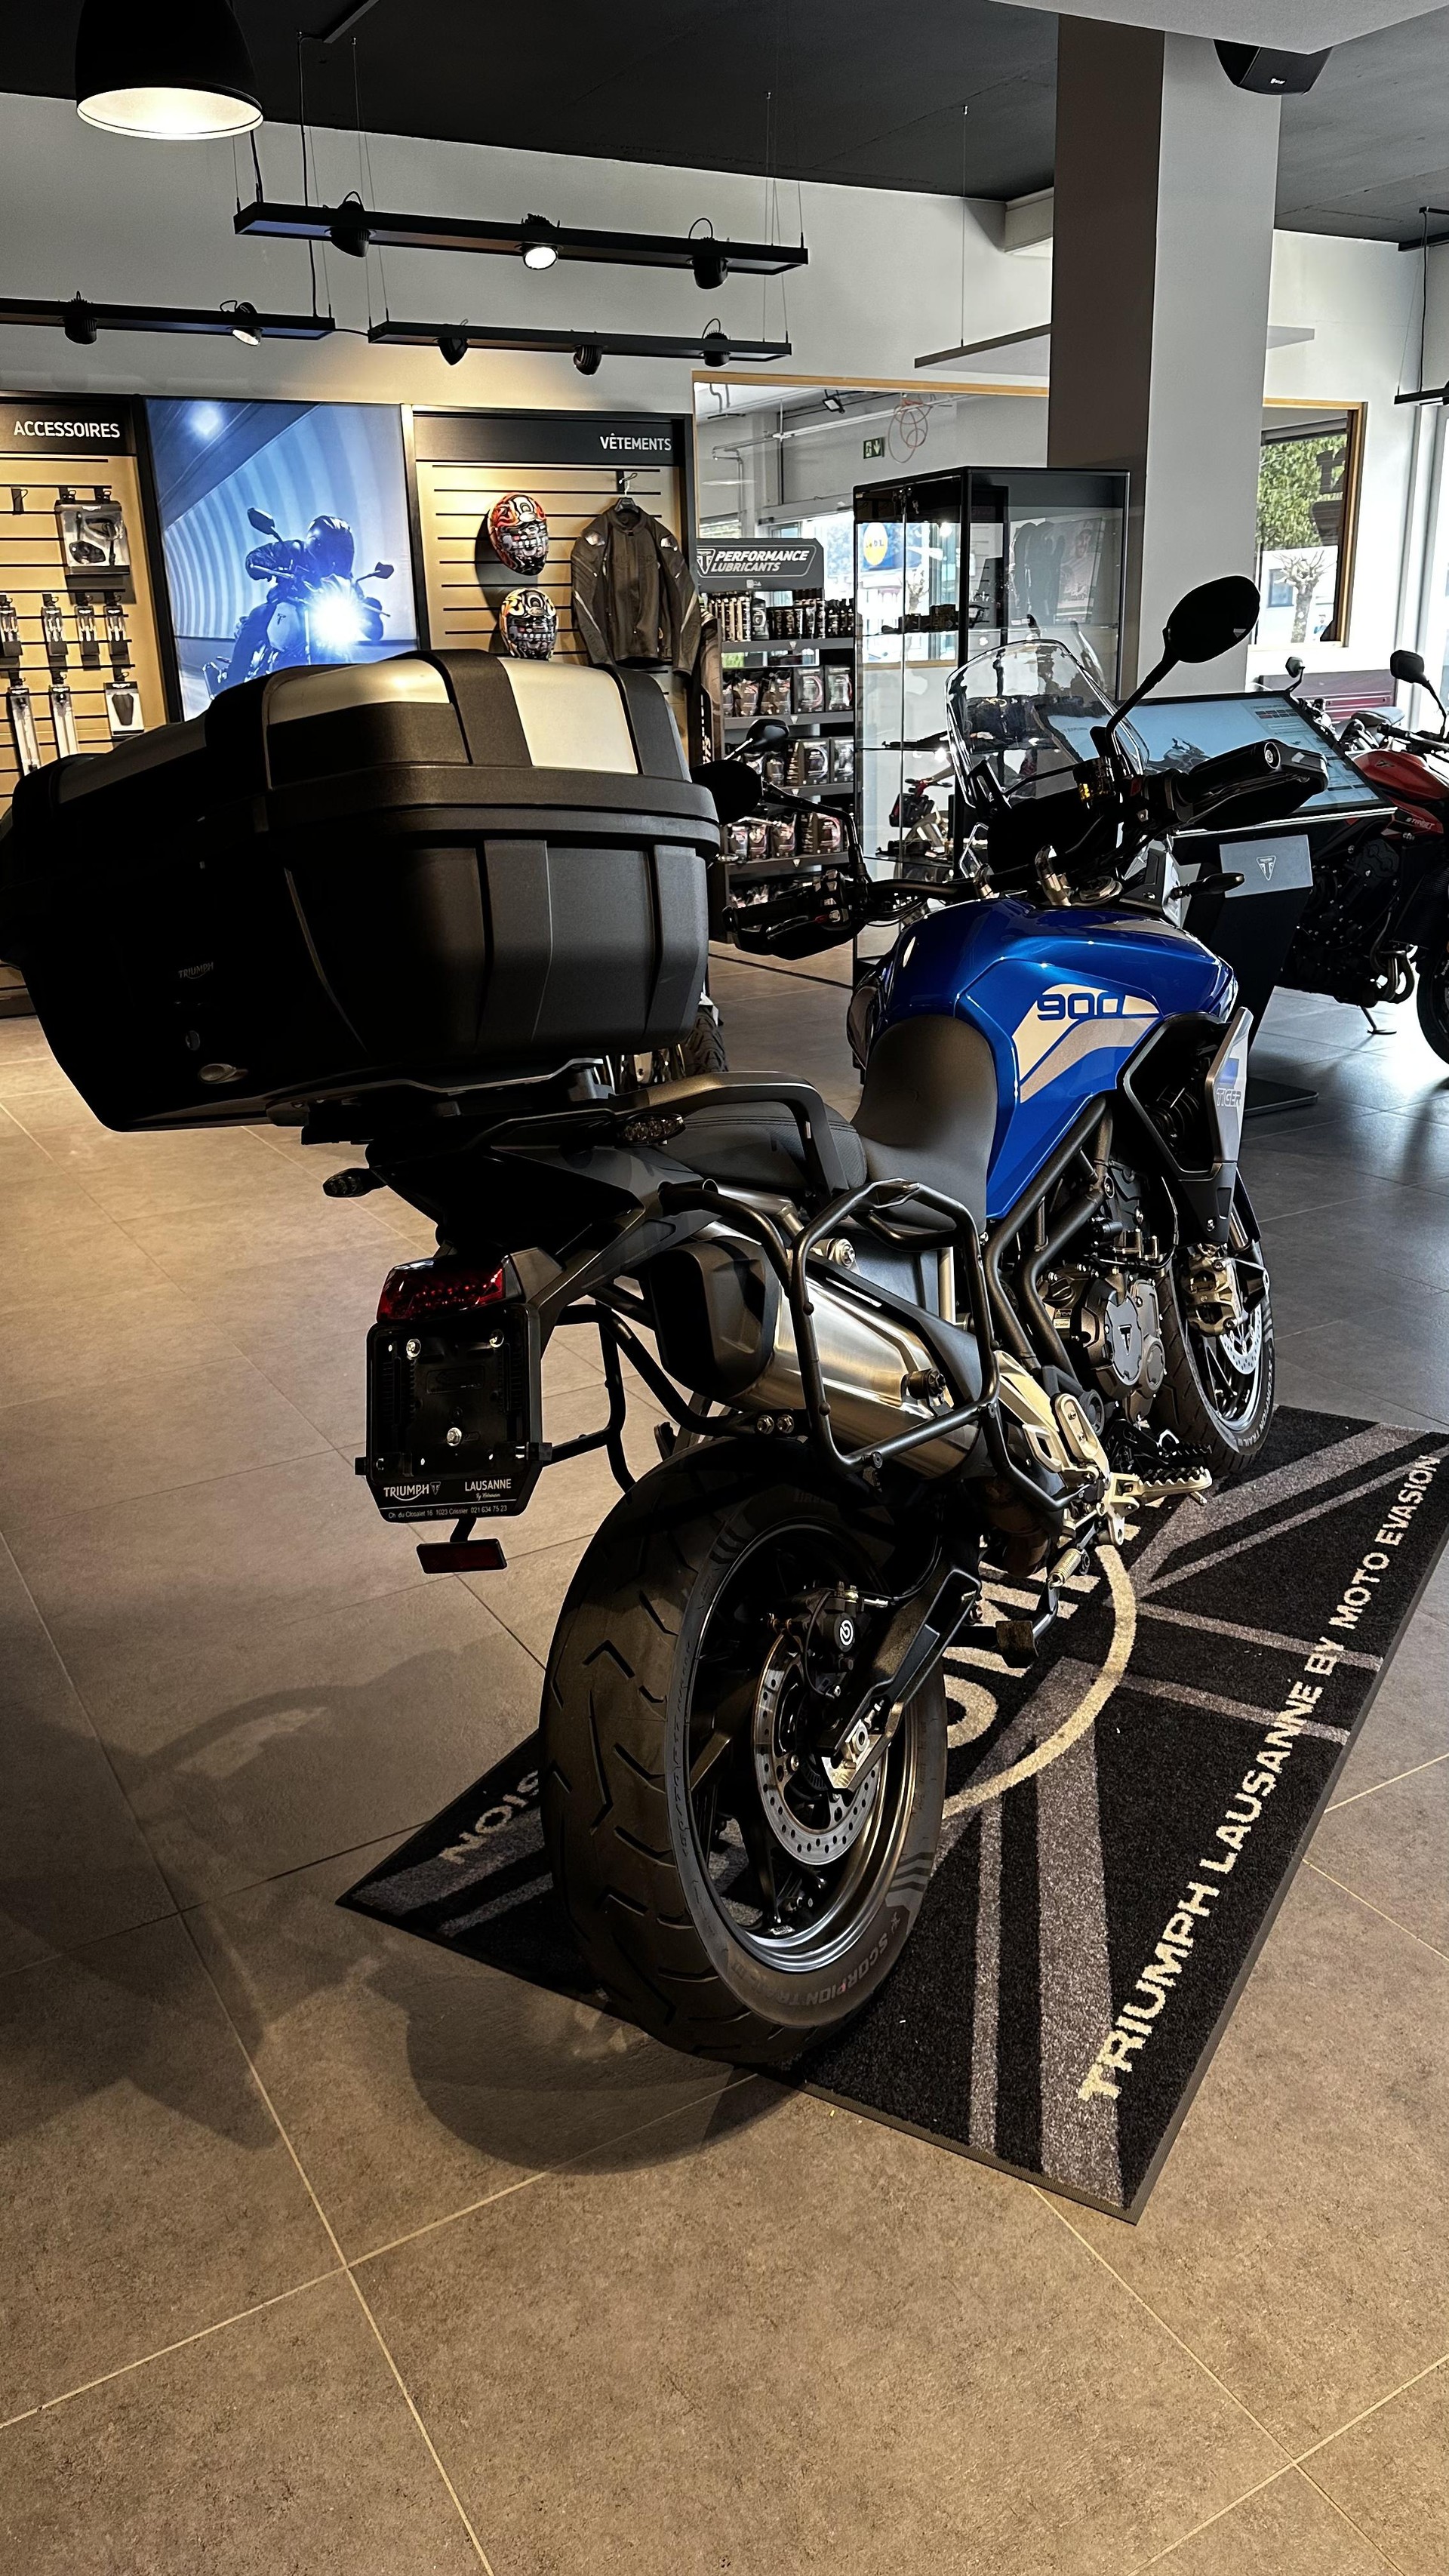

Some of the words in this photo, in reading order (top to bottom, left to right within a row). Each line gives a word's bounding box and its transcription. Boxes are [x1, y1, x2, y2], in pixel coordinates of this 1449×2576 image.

[14, 420, 121, 439] ACCESSOIRES
[600, 432, 672, 451] VÊTEMENTS
[714, 549, 811, 562] PERFORMANCE
[710, 562, 782, 573] LUBRICANTS
[178, 962, 214, 979] TRIUMPH
[1037, 993, 1124, 1021] 900
[1216, 1088, 1242, 1107] TIGER
[383, 1483, 430, 1501] TRIUMPH
[464, 1479, 512, 1492] LAUSANNE
[1078, 1882, 1220, 2102] TRIUMPH
[1199, 1682, 1324, 1875] LAUSANNE
[1303, 1636, 1346, 1676] BY
[1329, 1551, 1389, 1630] MOTO
[1374, 1454, 1441, 1547] EVASION
[439, 1769, 540, 1865] SION
[806, 1932, 889, 2007] SCORPION
